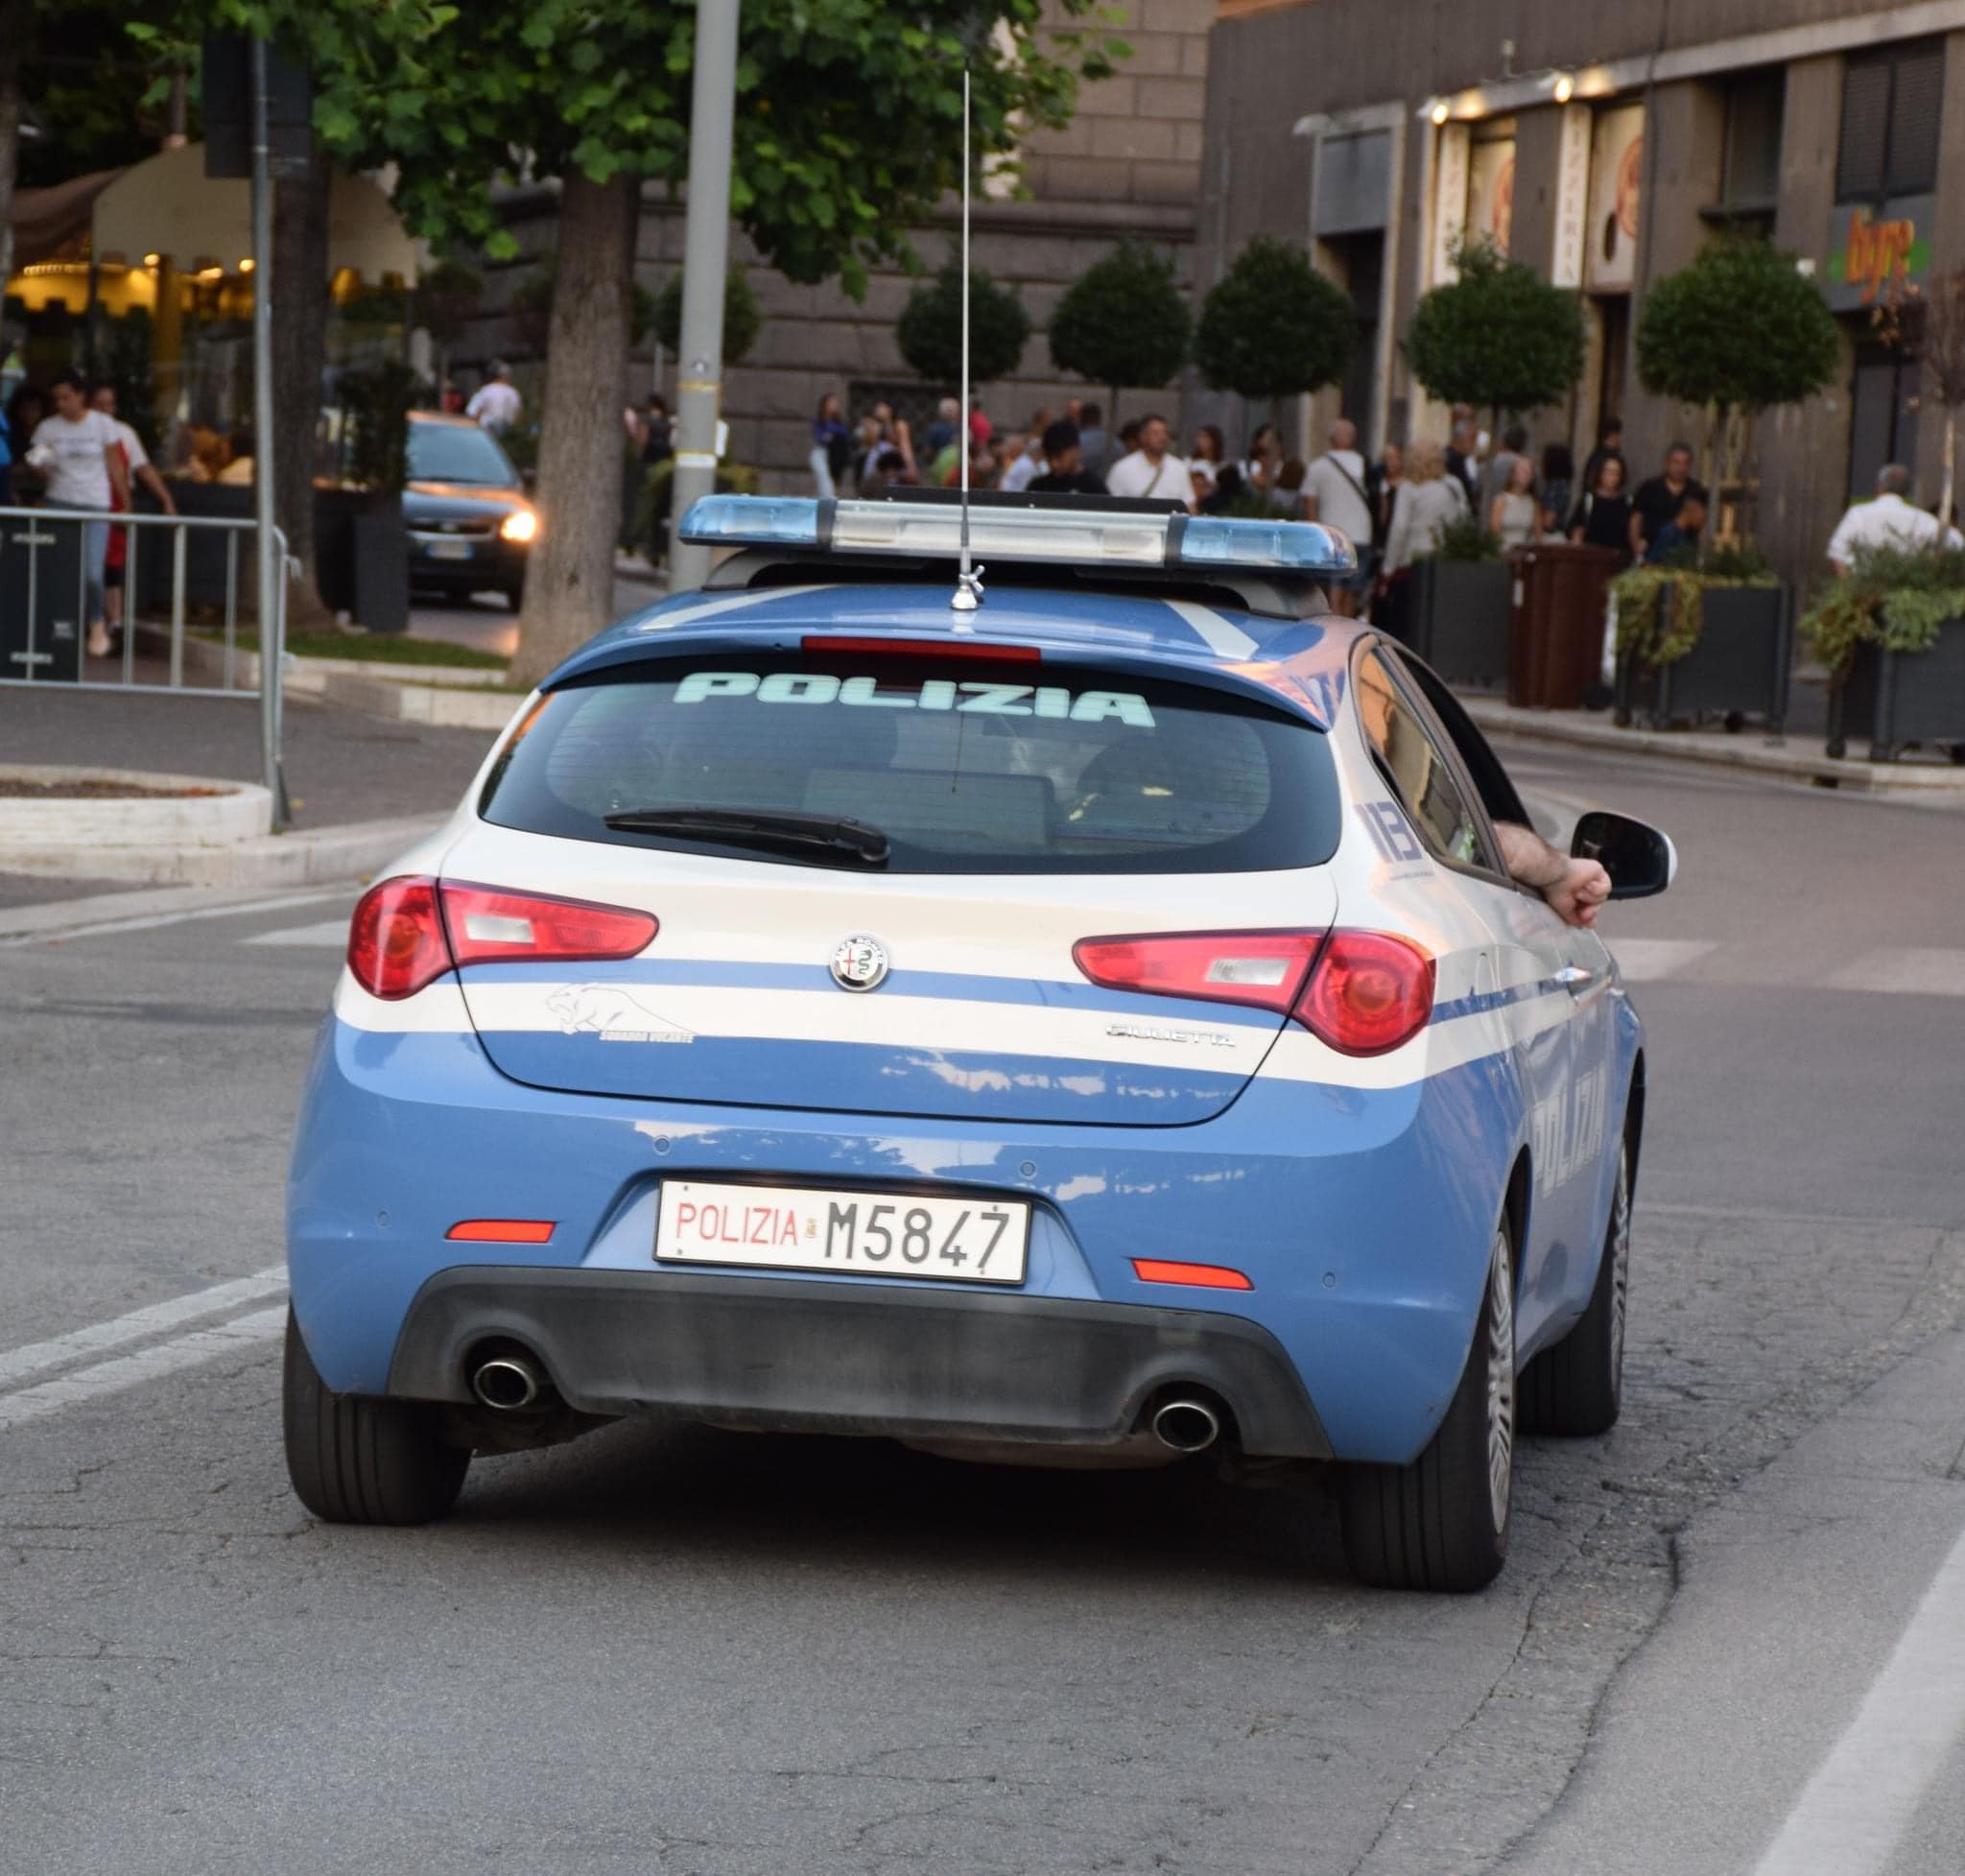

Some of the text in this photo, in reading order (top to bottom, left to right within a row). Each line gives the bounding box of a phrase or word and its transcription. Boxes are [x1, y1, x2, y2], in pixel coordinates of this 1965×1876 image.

[674, 672, 1155, 727] POLIZIA
[675, 1201, 1011, 1269] POLIZIA M5847
